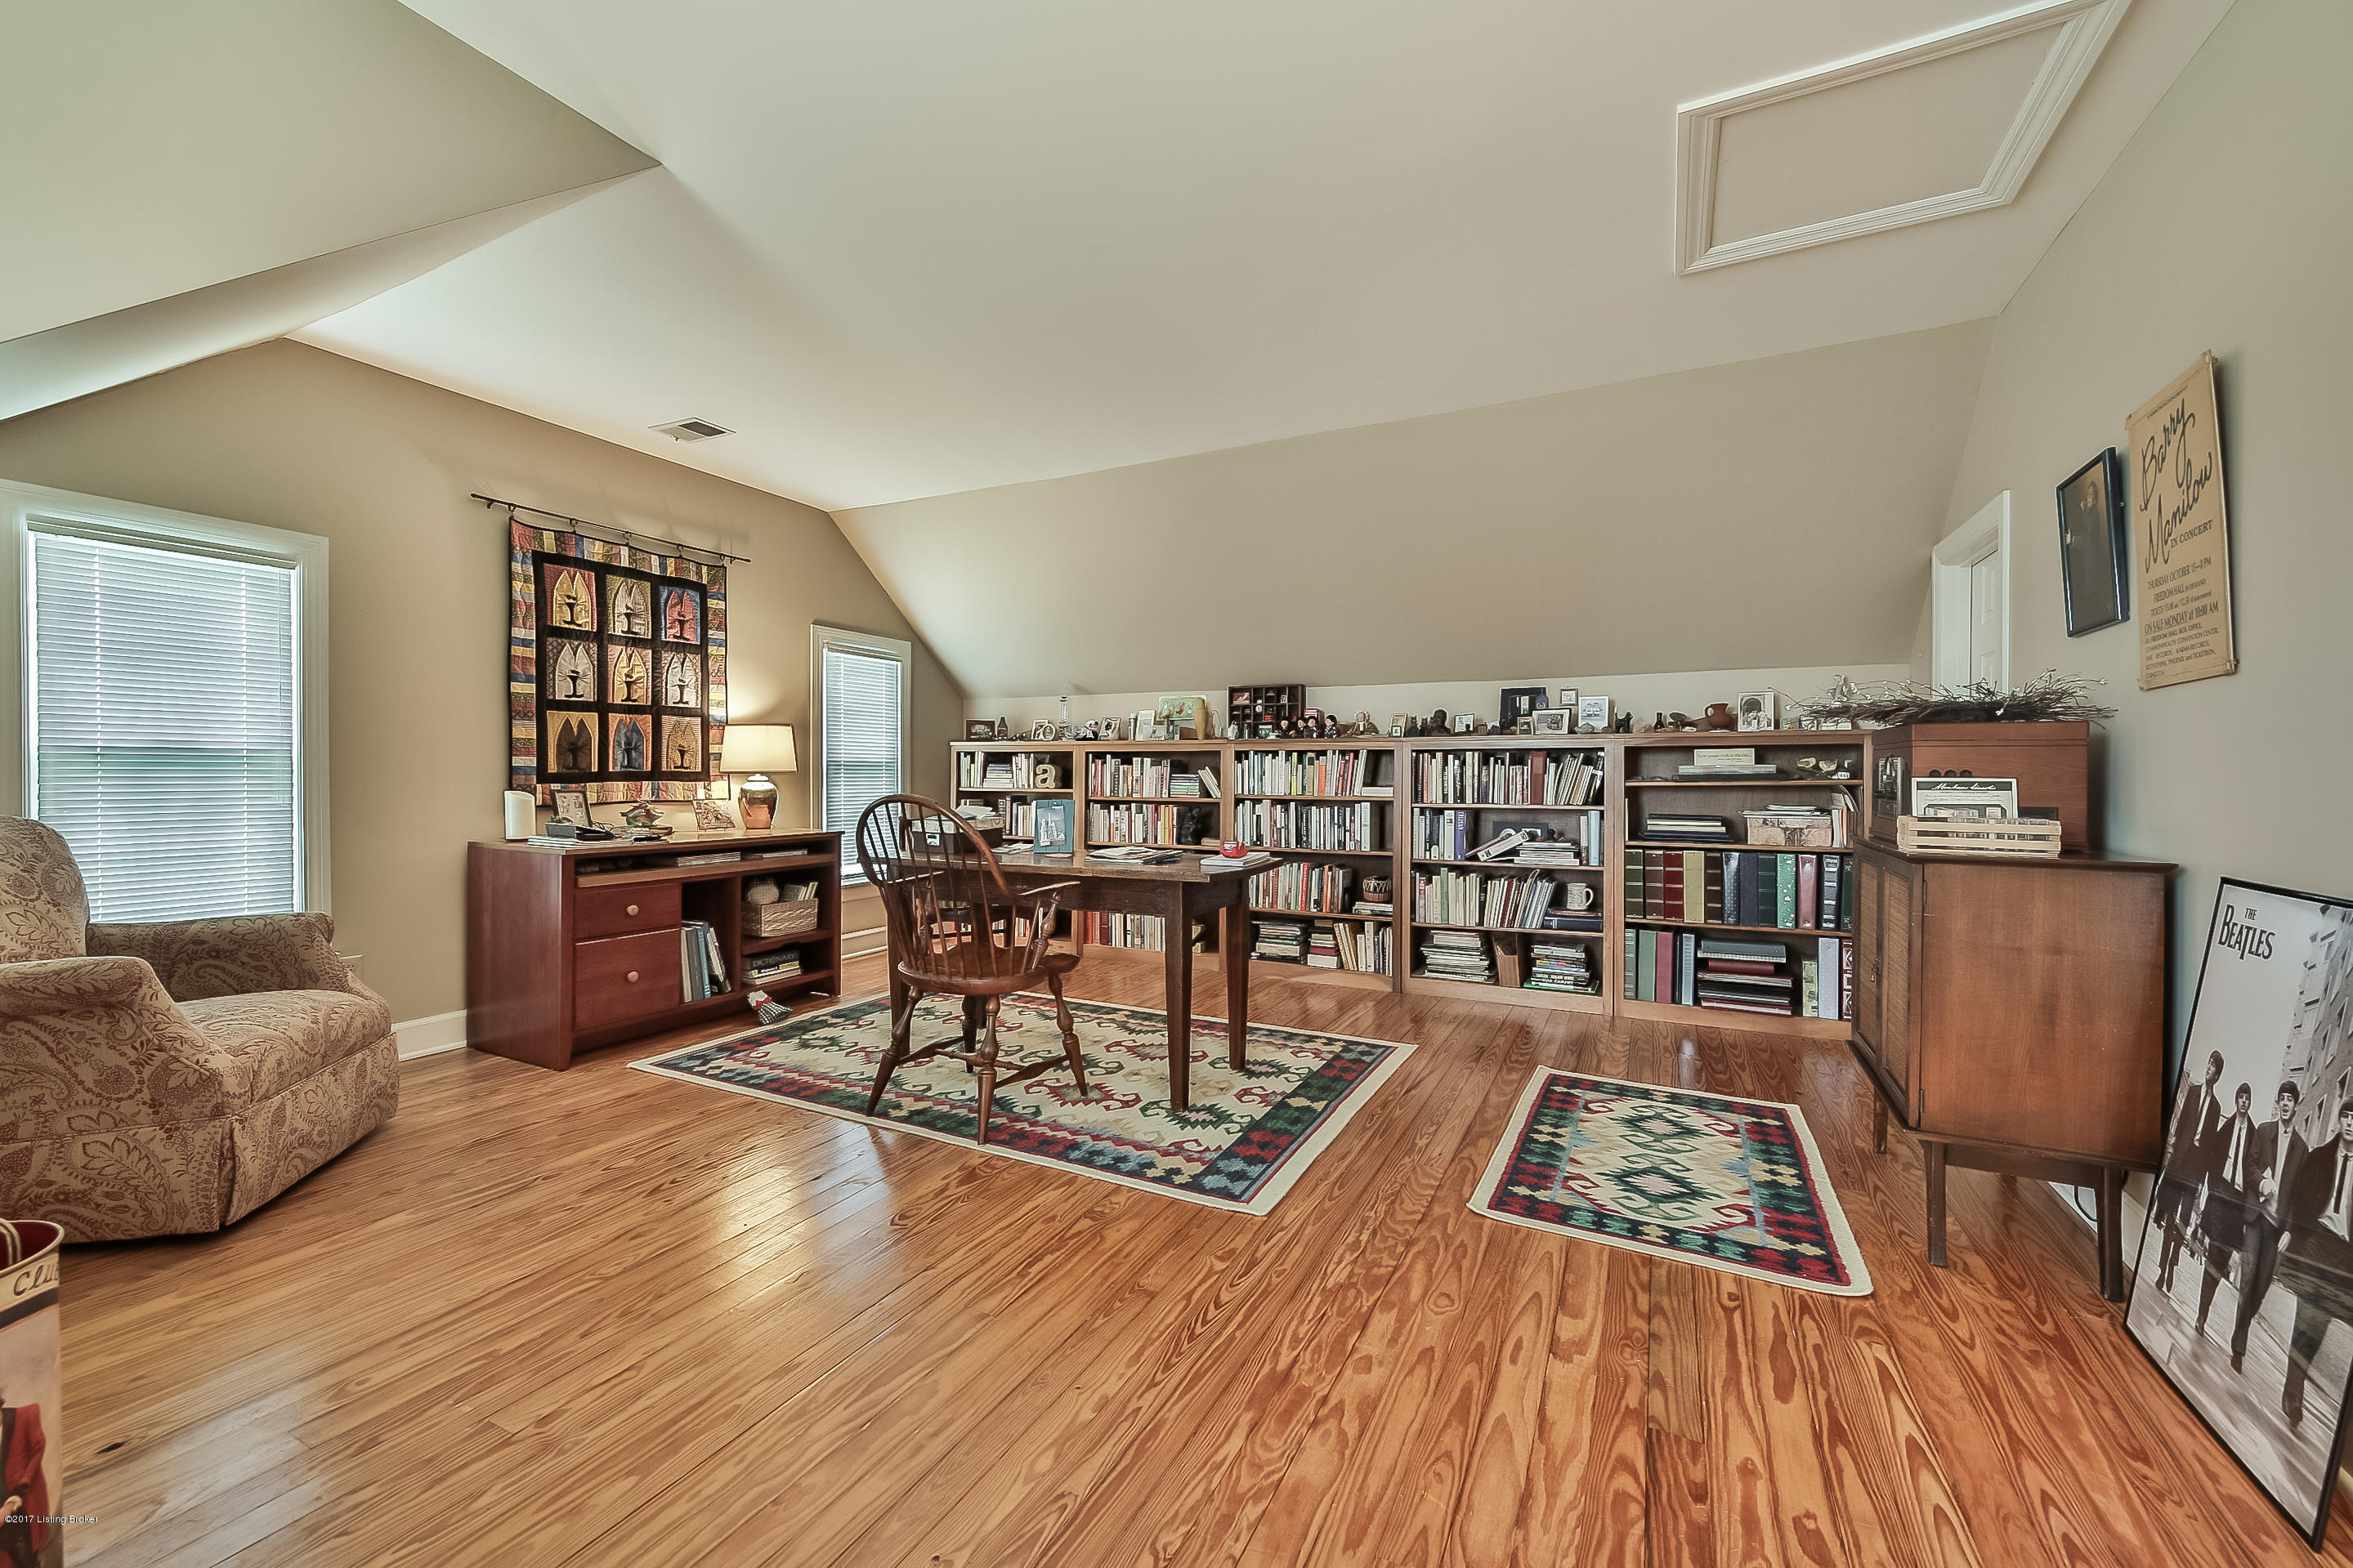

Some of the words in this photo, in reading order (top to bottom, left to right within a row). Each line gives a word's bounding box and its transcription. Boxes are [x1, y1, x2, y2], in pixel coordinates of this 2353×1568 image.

[2139, 398, 2195, 511] Barry
[2145, 452, 2212, 574] Manilow
[2170, 538, 2177, 548] IN
[2179, 520, 2212, 543] CONCERT
[2147, 574, 2169, 590] THURSDAY
[2169, 565, 2190, 582] OCTOBER
[2153, 588, 2174, 603] FREEDOM
[2173, 583, 2185, 595] HALL
[2144, 623, 2153, 635] ON
[2153, 619, 2163, 632] SALE
[2164, 610, 2188, 628] MONDAY
[2208, 601, 2219, 614] AM
[2150, 632, 2167, 643] FREEDOM
[2178, 626, 2188, 634] BOX
[2176, 632, 2203, 644] CONVENTION
[1035, 764, 1055, 788] a
[2244, 907, 2258, 921] THE
[2217, 904, 2276, 961] BEATLES
[753, 953, 796, 967] DICTIONARY
